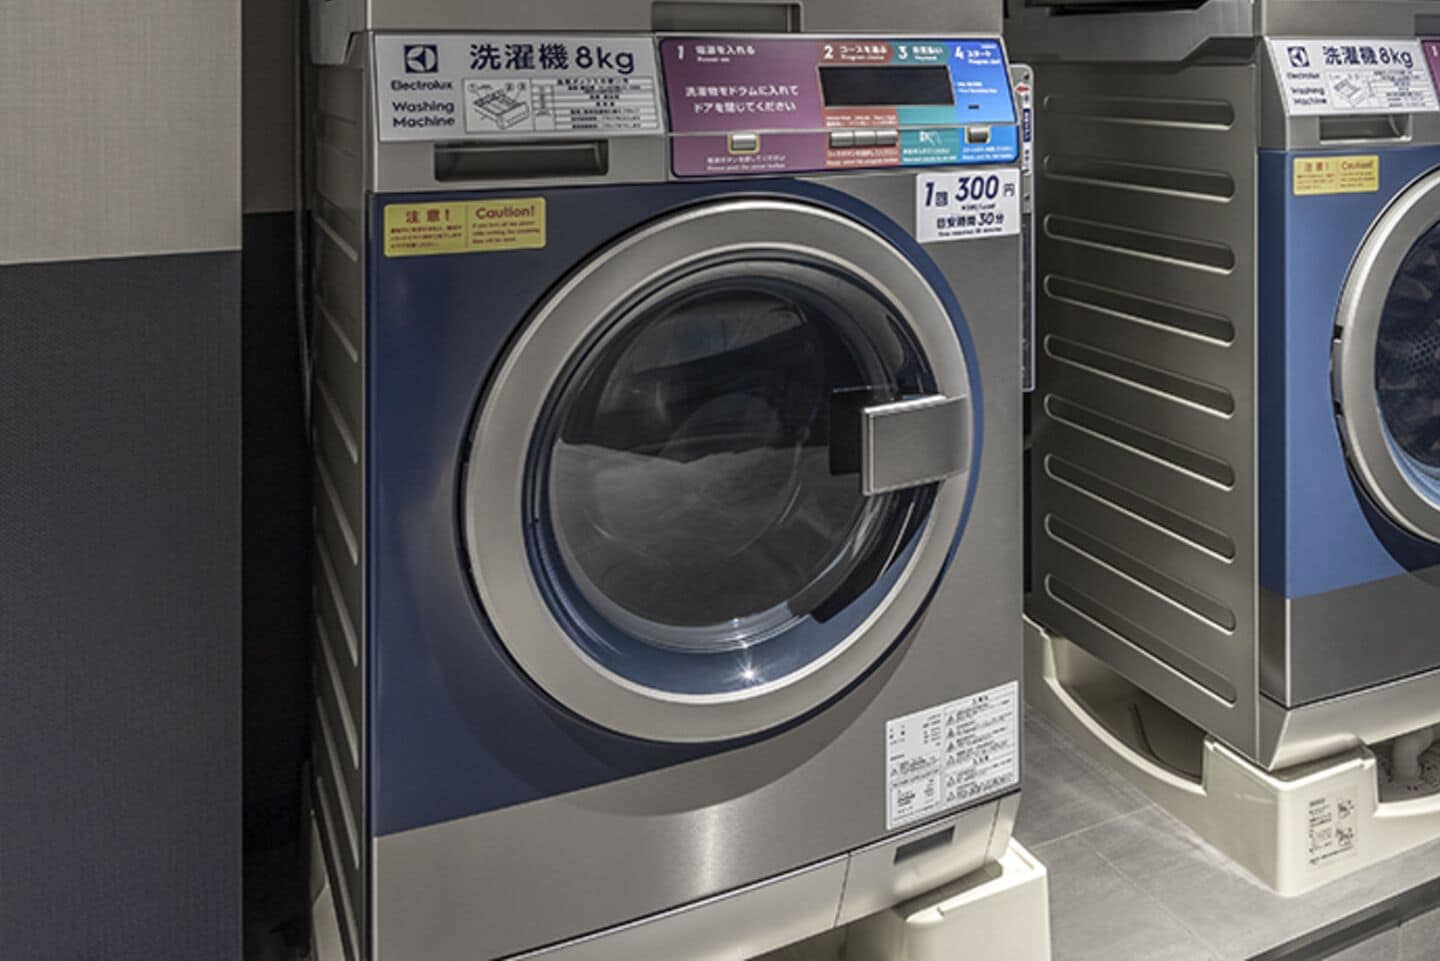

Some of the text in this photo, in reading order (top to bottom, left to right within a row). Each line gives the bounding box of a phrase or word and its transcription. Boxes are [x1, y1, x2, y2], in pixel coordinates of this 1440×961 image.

[470, 43, 635, 74] 洗濯機8kg
[677, 45, 685, 60] 1
[823, 45, 834, 60] 2
[898, 45, 908, 60] 3
[954, 45, 965, 60] 4
[390, 80, 453, 92] Electrolux
[392, 101, 455, 115] Washing
[393, 116, 455, 129] Machine
[475, 205, 535, 220] Caution!
